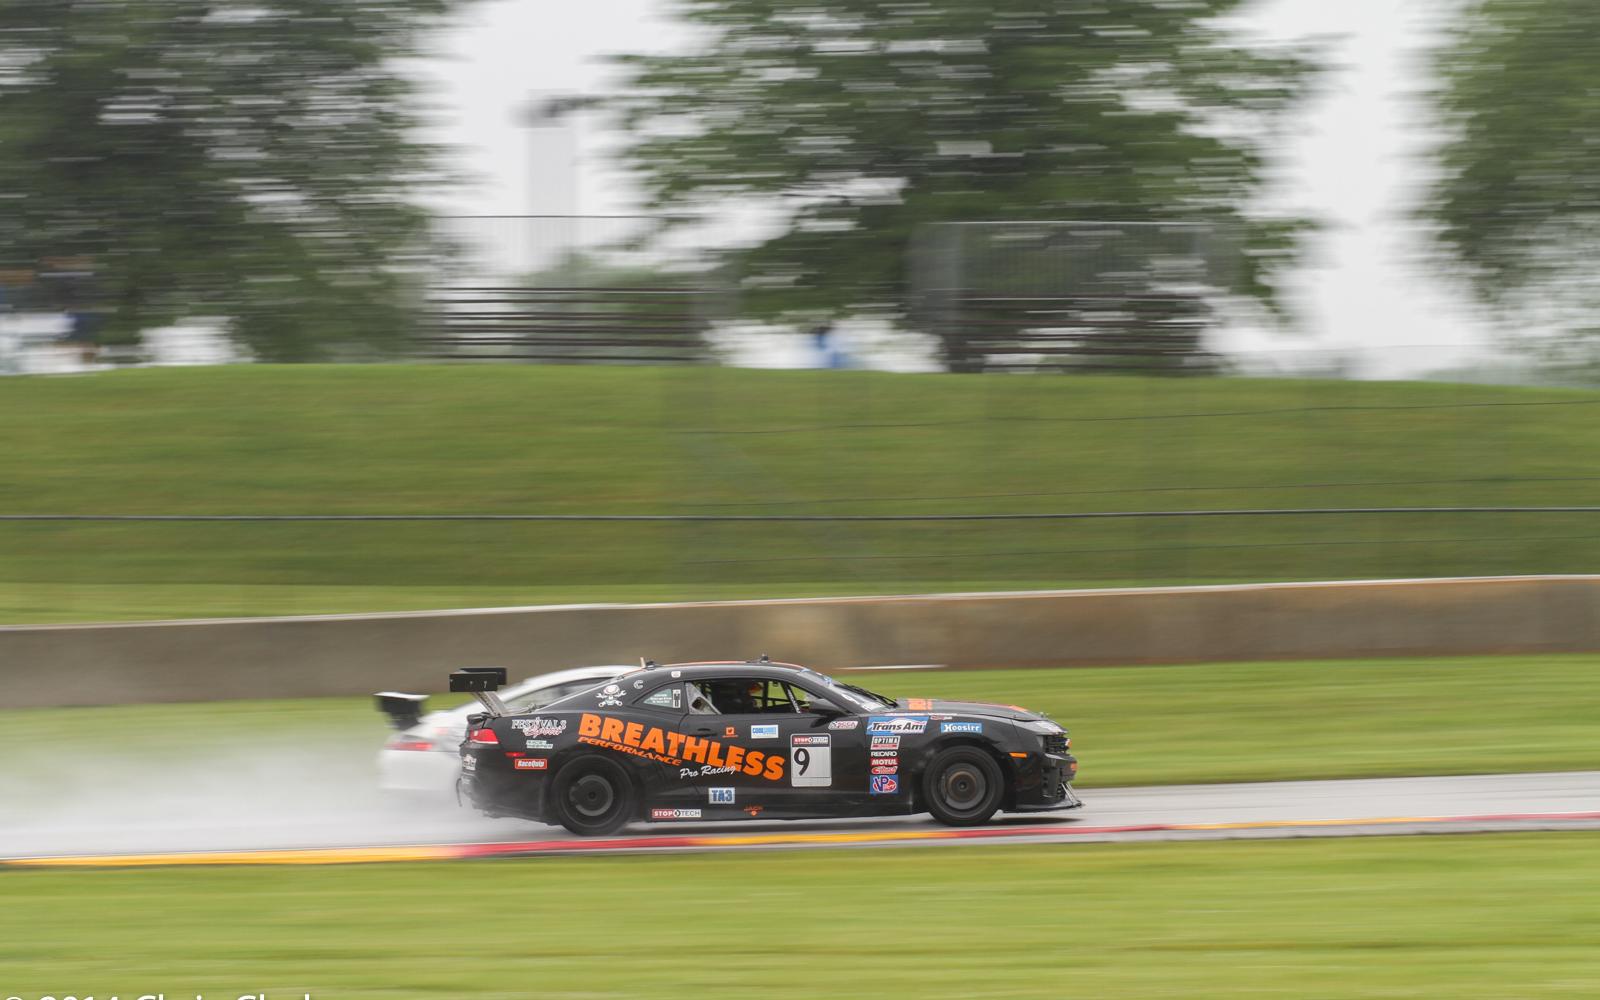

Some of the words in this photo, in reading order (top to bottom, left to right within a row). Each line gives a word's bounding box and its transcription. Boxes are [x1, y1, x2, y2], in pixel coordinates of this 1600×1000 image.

[872, 722, 901, 731] Trans
[902, 722, 923, 731] Am
[943, 723, 980, 732] Hoosier
[873, 736, 899, 744] OPTIMA
[577, 713, 785, 781] BREATHLESS
[577, 736, 683, 766] PERFORMANCE
[793, 748, 810, 776] 9
[871, 758, 898, 766] MOTUL
[679, 766, 699, 779] Pro
[700, 764, 736, 777] Racing
[711, 789, 733, 802] TA3
[653, 810, 675, 818] STOP
